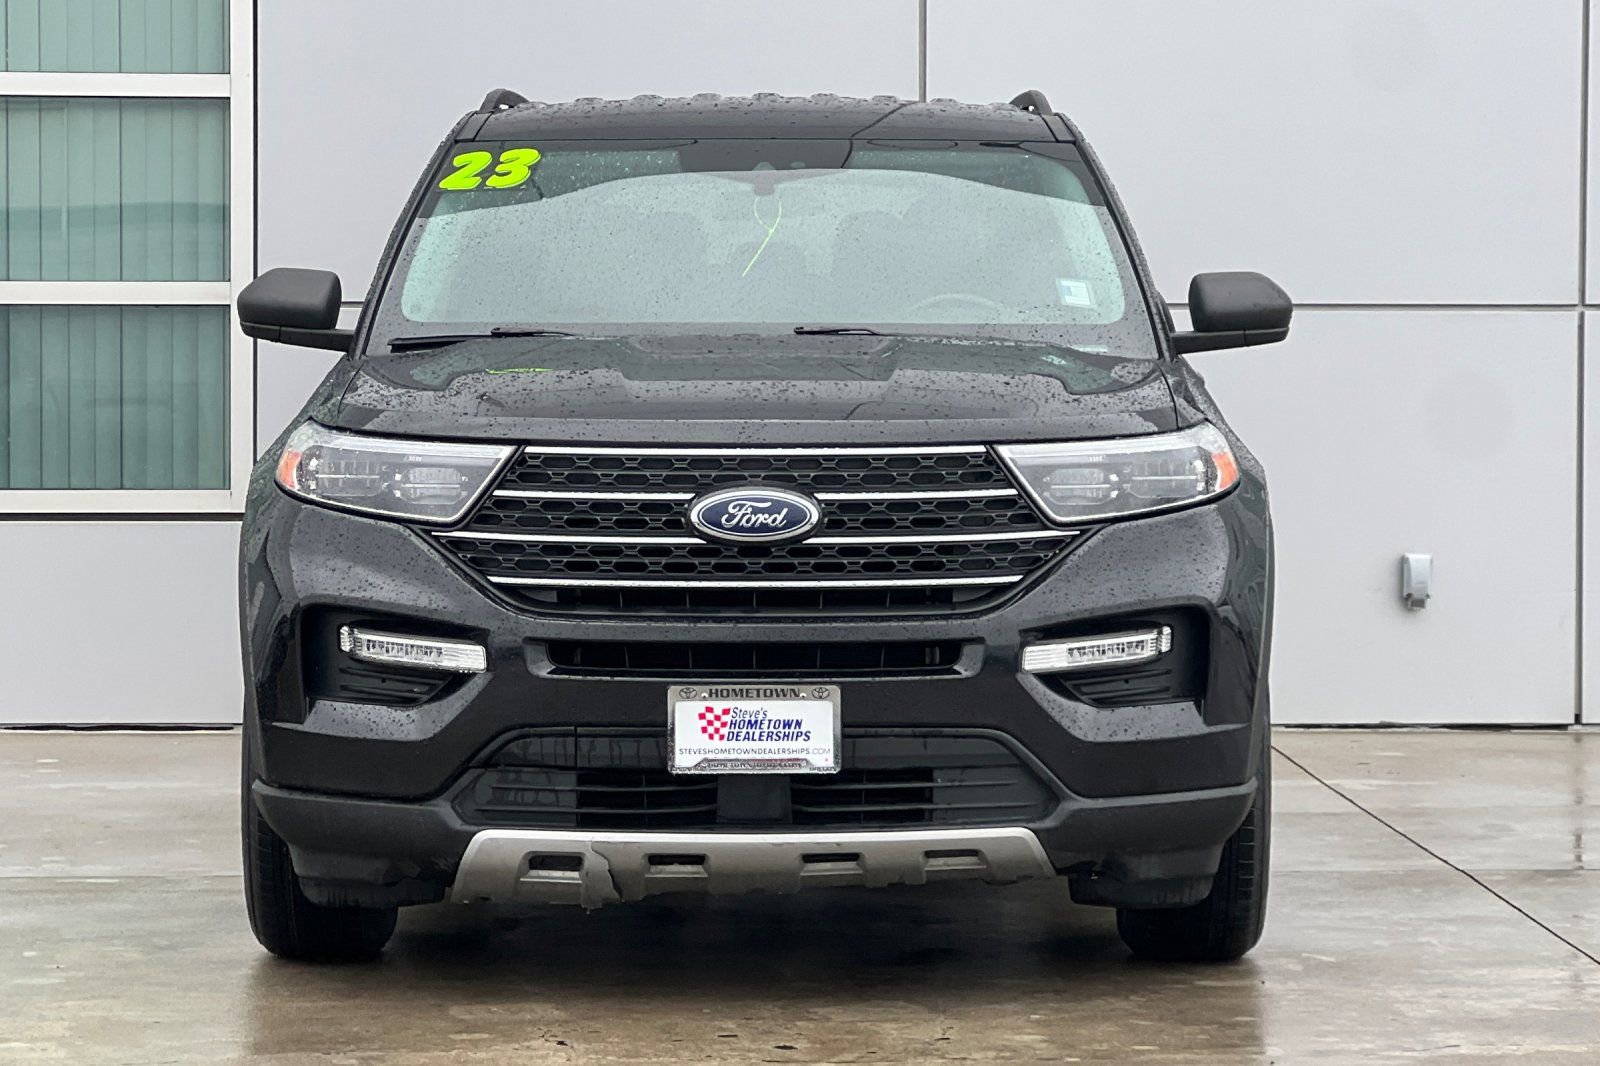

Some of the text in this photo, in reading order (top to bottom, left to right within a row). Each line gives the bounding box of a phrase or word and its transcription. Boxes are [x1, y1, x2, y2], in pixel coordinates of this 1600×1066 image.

[439, 148, 541, 190] 23
[721, 500, 788, 528] Ford
[708, 688, 801, 698] HOMETOWN
[731, 707, 768, 719] Steve's
[729, 719, 803, 730] HOMETOWN
[726, 731, 812, 742] DEALERSHIPS
